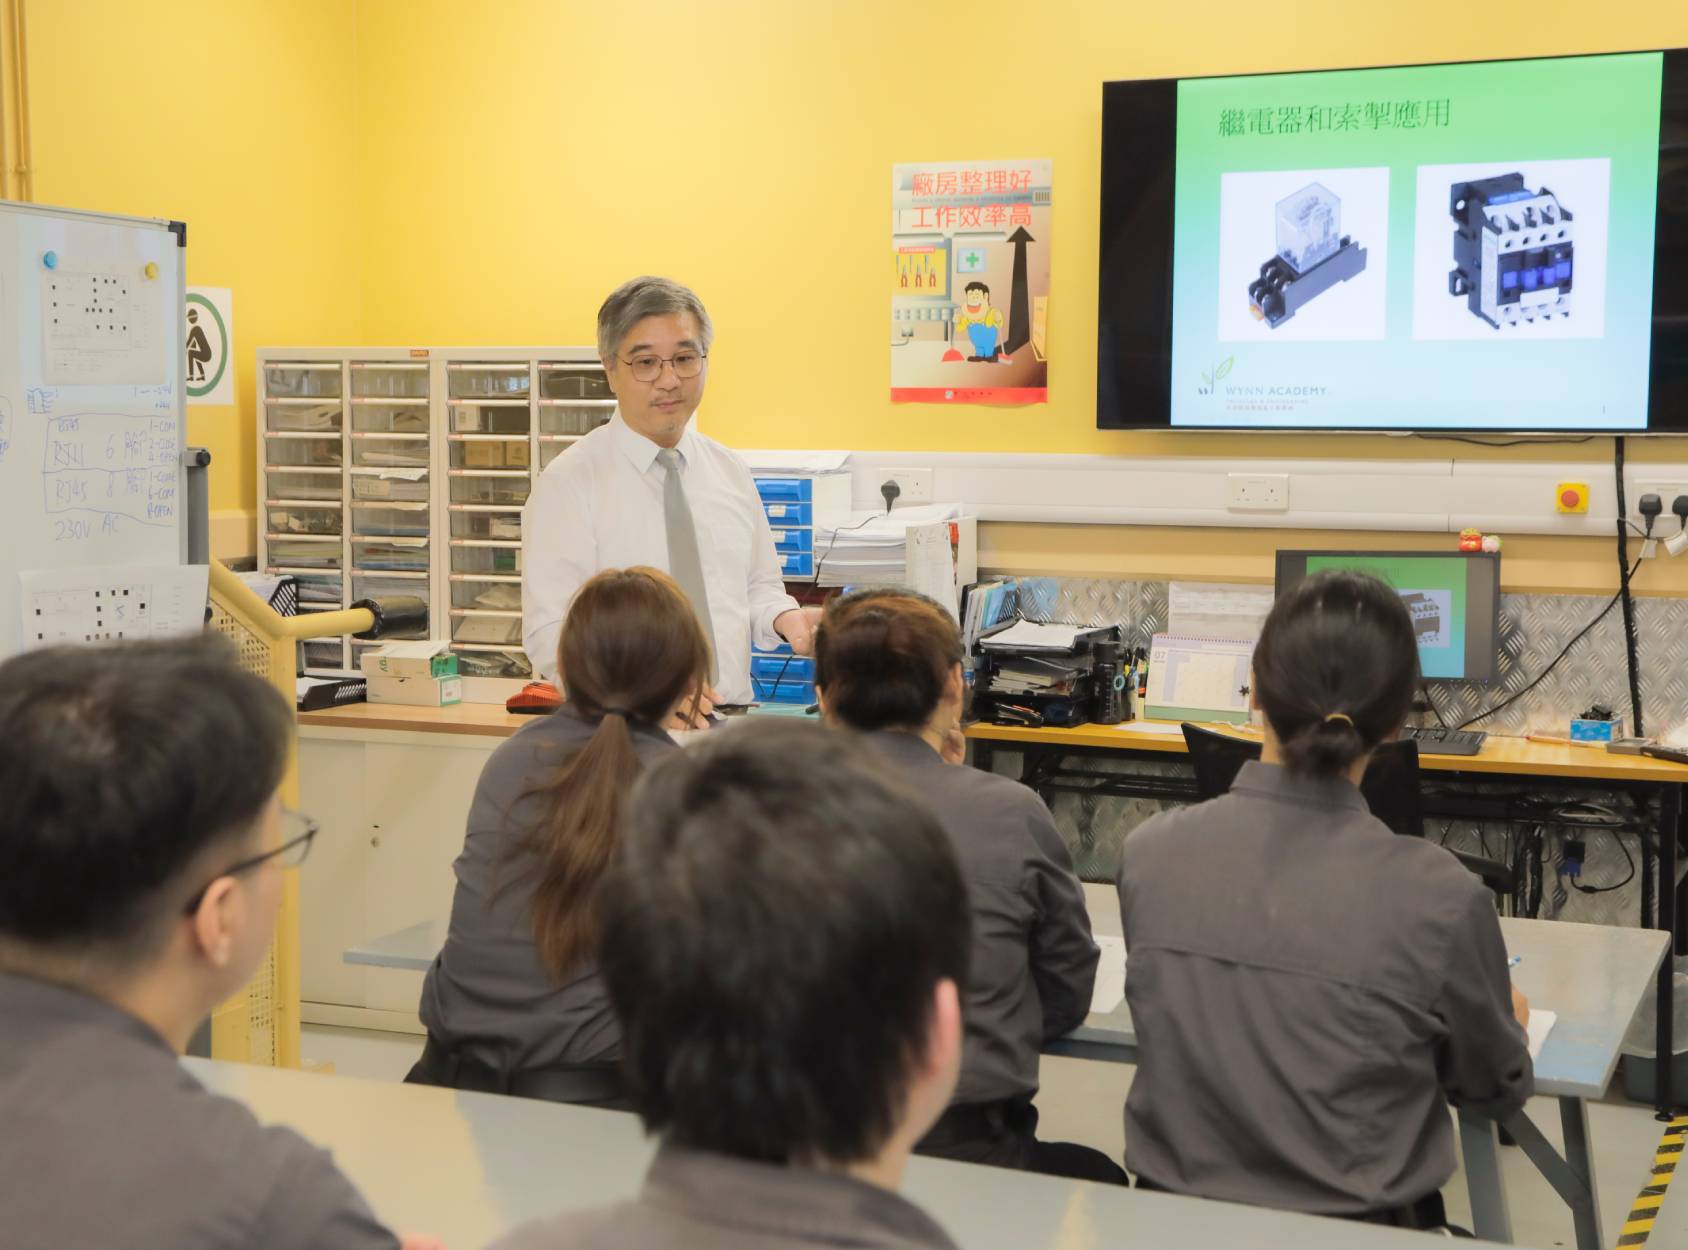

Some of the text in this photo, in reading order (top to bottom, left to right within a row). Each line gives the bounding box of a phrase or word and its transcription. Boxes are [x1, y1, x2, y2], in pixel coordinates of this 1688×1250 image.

[911, 169, 1032, 196] 廠房整理好
[911, 203, 1032, 229] 工作效率高
[1225, 386, 1327, 396] WYNN ACADEMY
[55, 519, 91, 541] 230V
